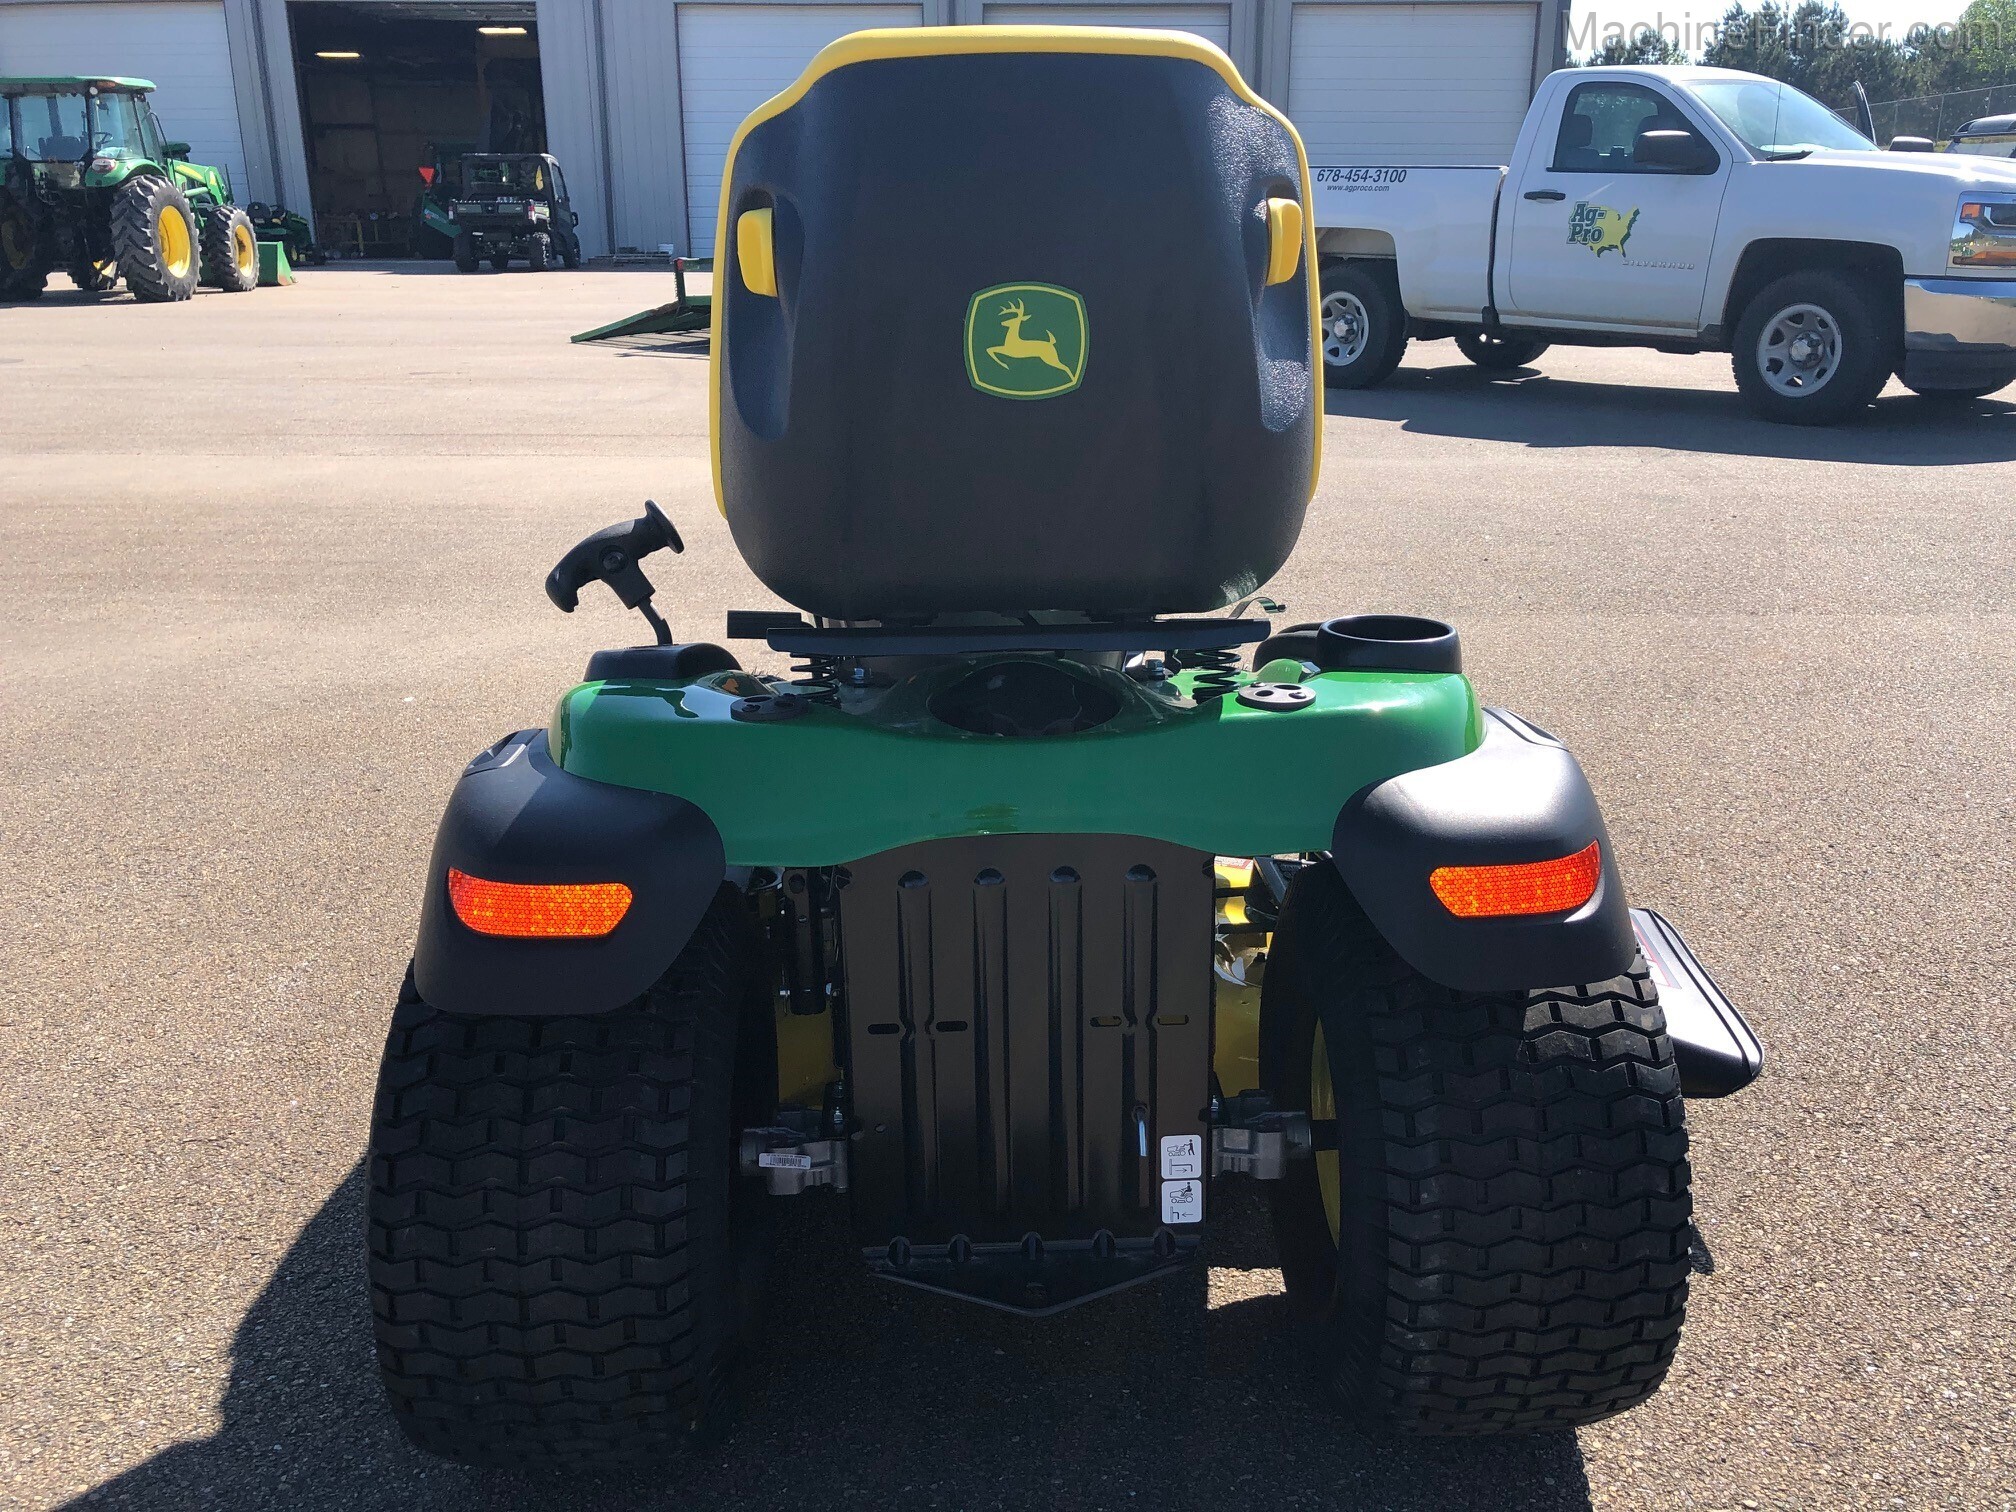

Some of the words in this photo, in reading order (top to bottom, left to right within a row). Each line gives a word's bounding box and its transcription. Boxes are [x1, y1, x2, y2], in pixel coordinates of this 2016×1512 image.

[1317, 169, 1407, 183] 678-454-3100
[1570, 202, 1606, 226] Ag-
[1567, 223, 1604, 243] Pro
